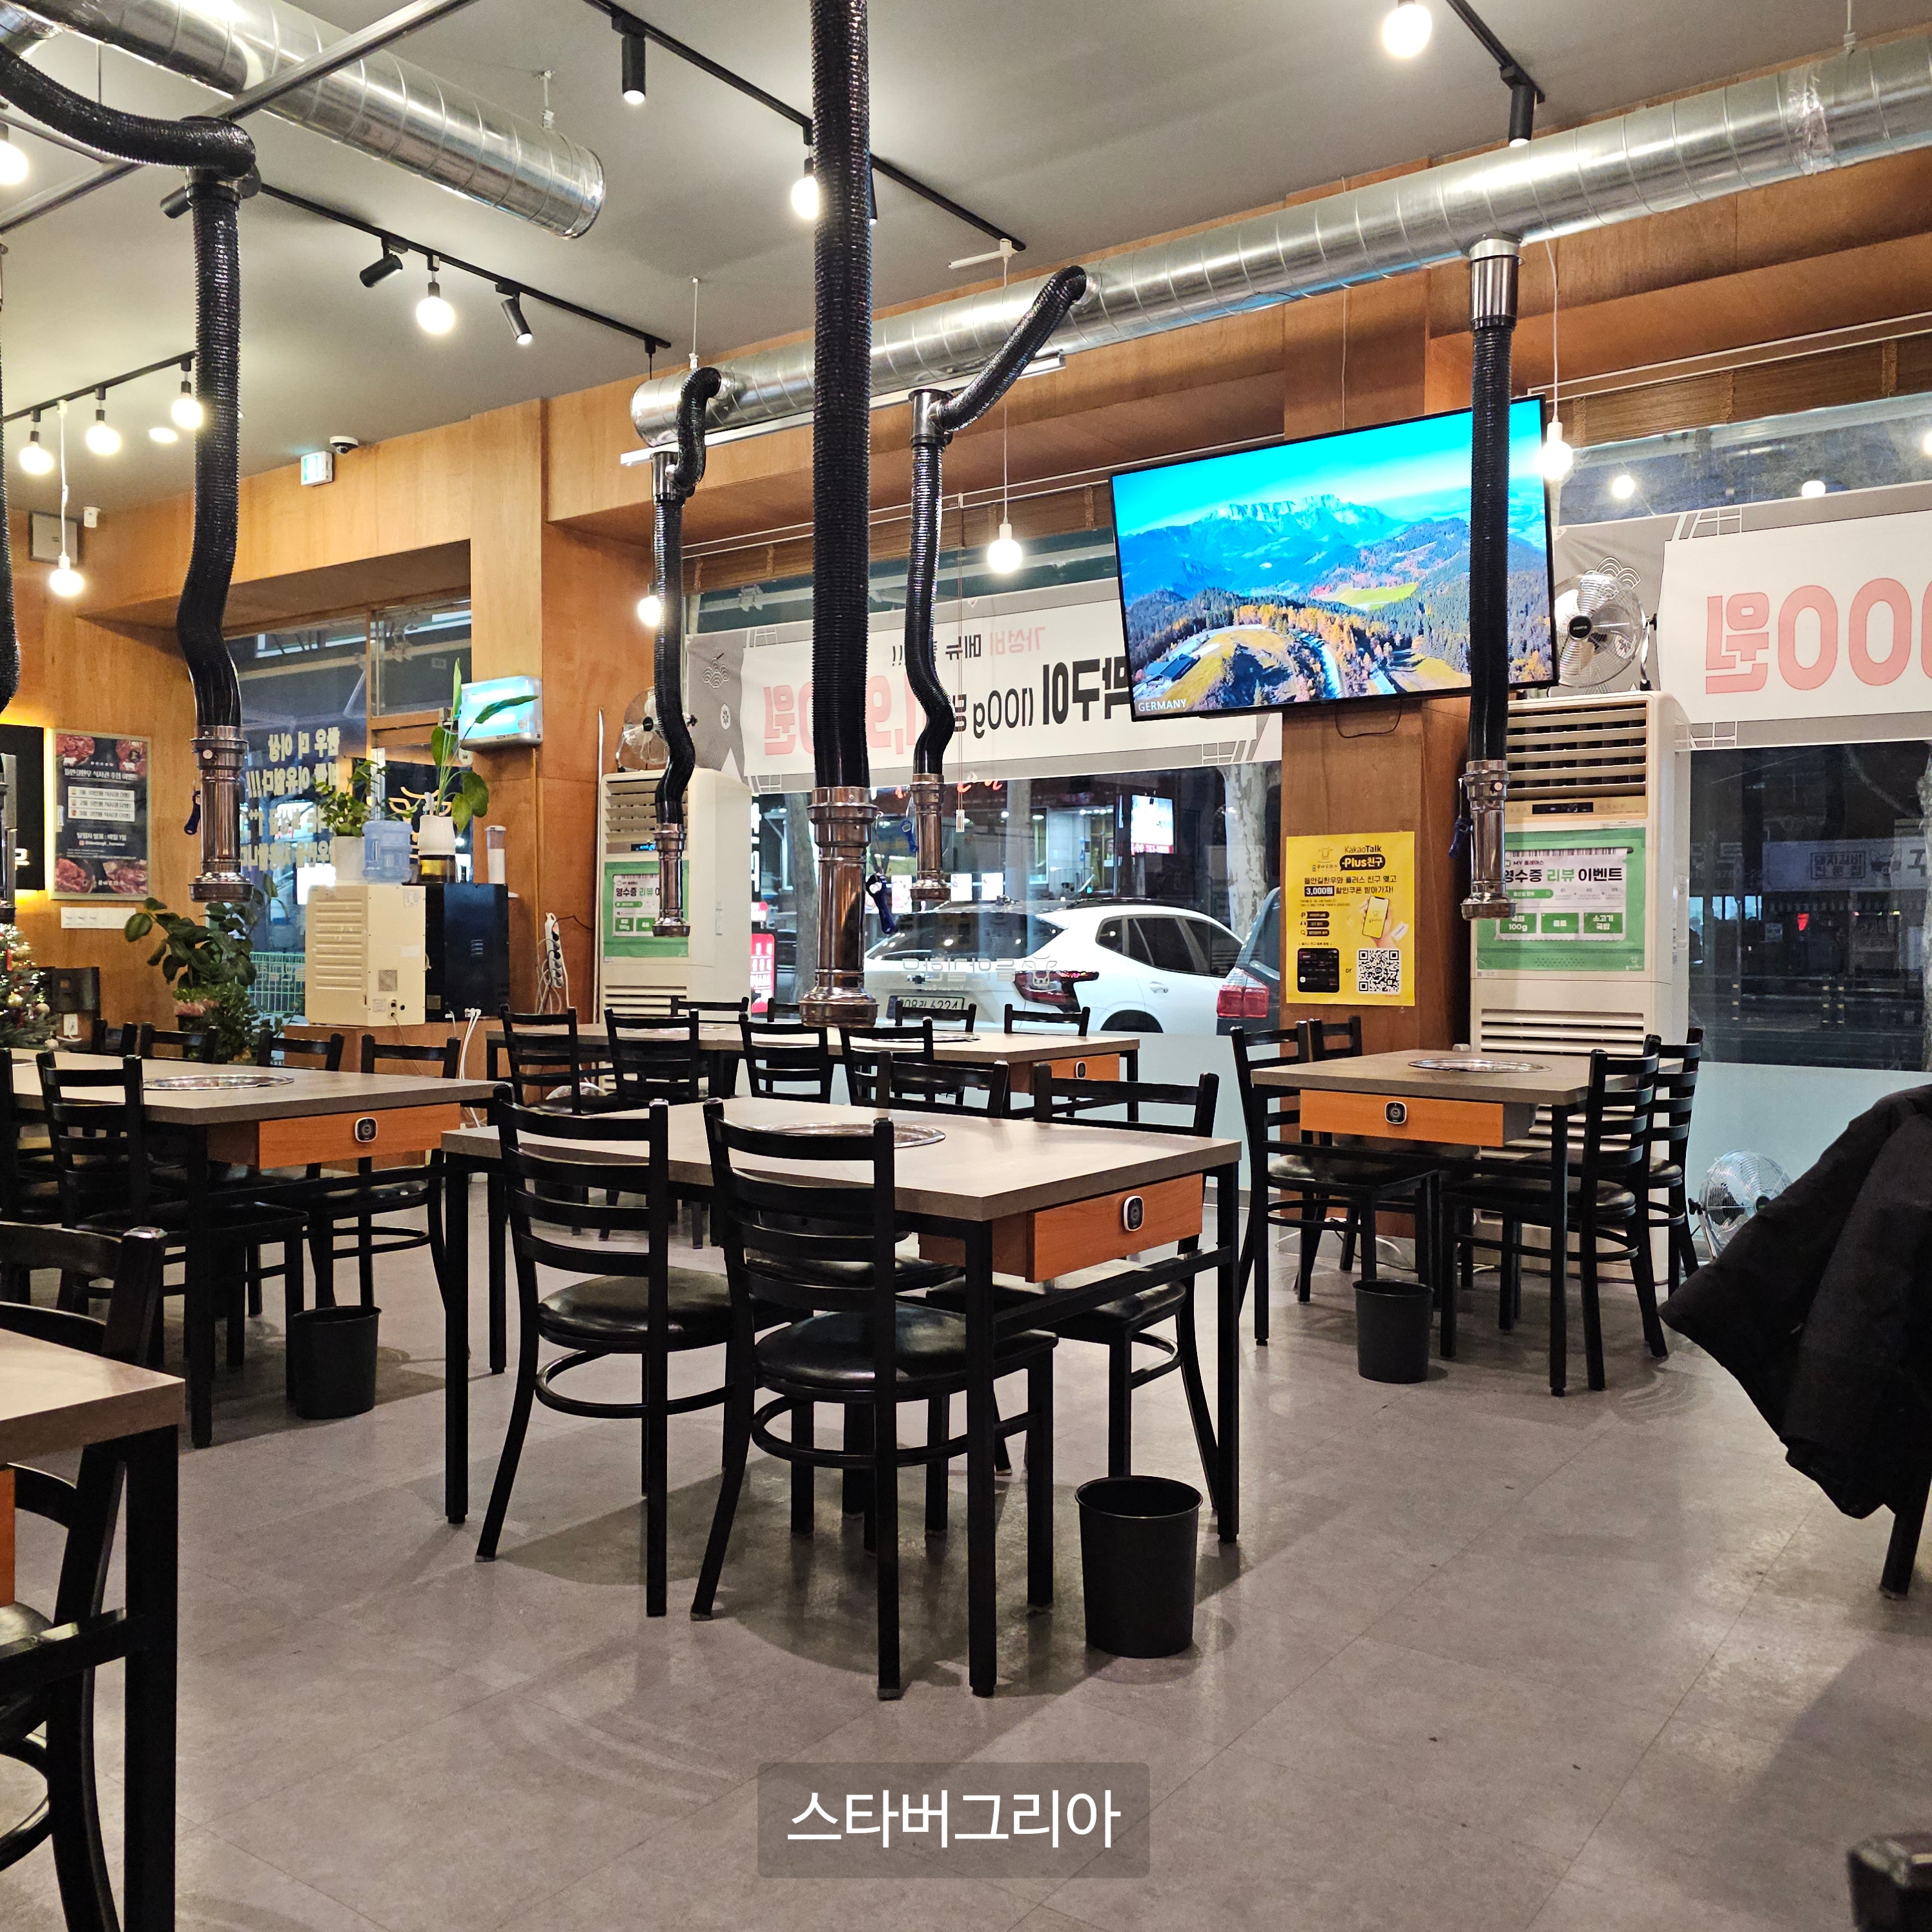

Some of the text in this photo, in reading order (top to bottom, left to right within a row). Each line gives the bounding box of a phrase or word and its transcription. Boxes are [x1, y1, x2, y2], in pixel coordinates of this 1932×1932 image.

[1138, 699, 1187, 712] GERMANY
[1304, 876, 1343, 885] 들안길한우와
[1505, 868, 1623, 883] 영수증 리뷰 이벤트
[616, 887, 637, 896] 영수증
[639, 887, 653, 896] 리뷰
[1306, 887, 1333, 896] 3,000원
[1364, 885, 1393, 894] 받아가자!
